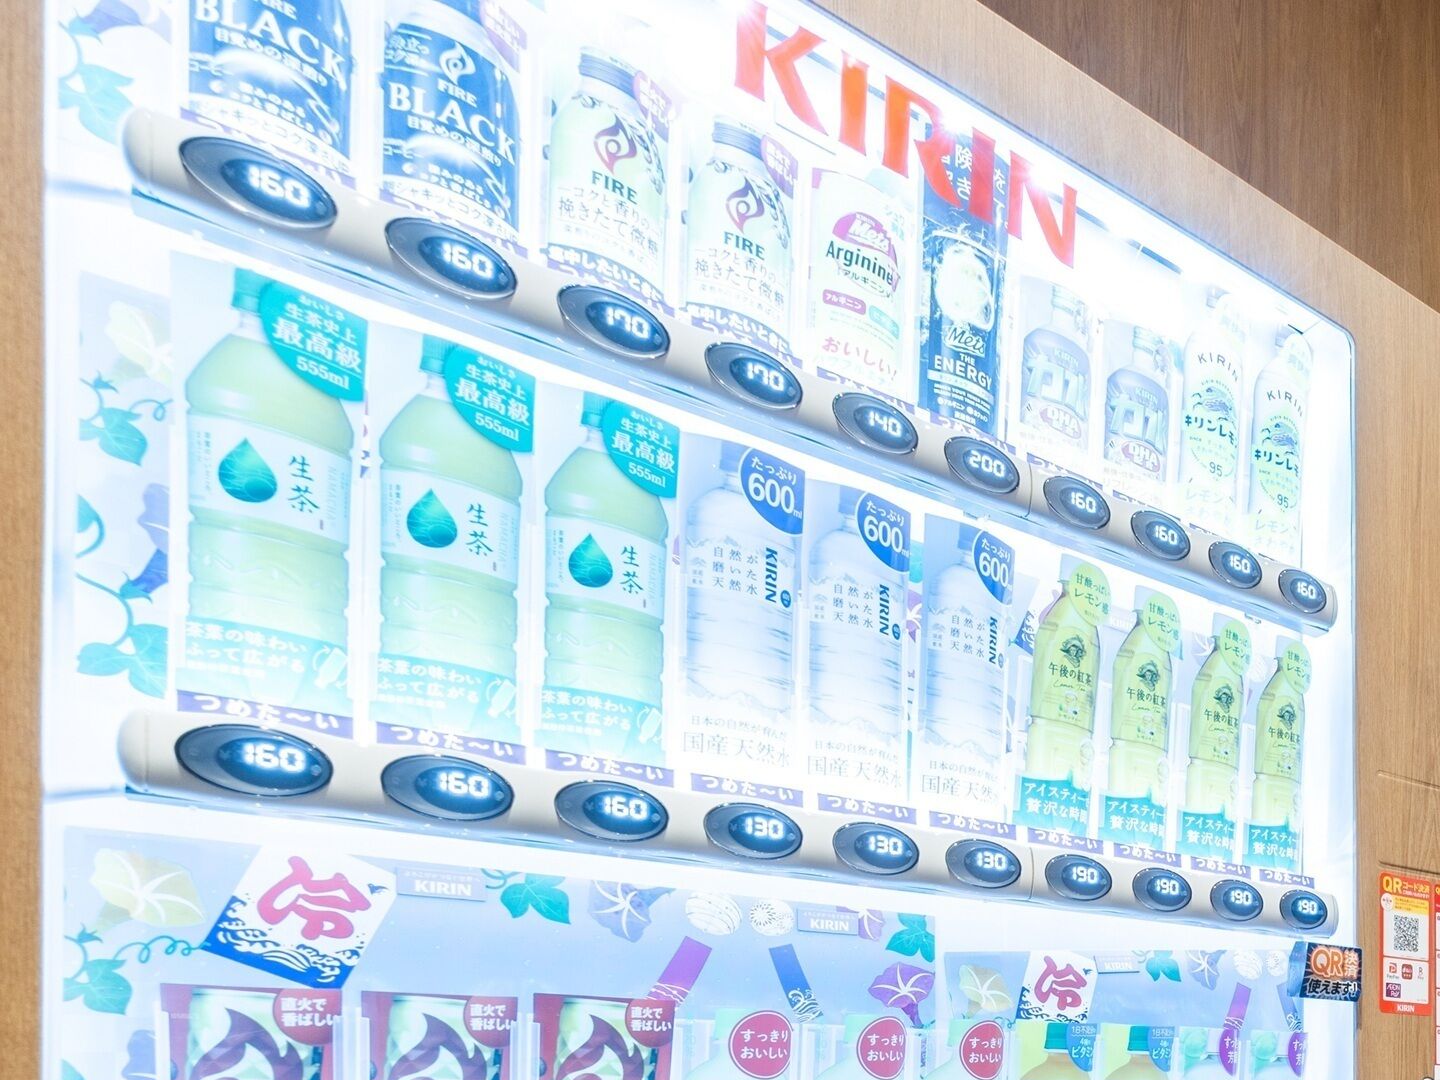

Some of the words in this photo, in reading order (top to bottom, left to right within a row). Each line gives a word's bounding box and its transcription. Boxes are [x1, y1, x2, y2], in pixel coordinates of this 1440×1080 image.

[389, 81, 516, 166] BLACK
[735, 2, 1078, 269] KIRIN
[591, 170, 637, 206] FIRE
[723, 231, 765, 261] FIRE
[825, 240, 895, 287] Arginine
[286, 302, 358, 347] 生茶史上
[605, 307, 650, 339] 170
[273, 318, 363, 375] 最高級
[959, 352, 976, 367] THE
[296, 355, 351, 391] 555ml
[465, 364, 527, 401] 生茶史上
[747, 362, 786, 391] 170
[934, 354, 992, 391] ENERGY
[454, 378, 531, 426] 最高級
[475, 412, 521, 443] 555ml
[611, 431, 676, 474] 最高級
[968, 451, 1005, 477] 200
[287, 455, 320, 514] 生茶
[628, 461, 667, 489] 555ml
[750, 456, 798, 485] たっぷり
[865, 499, 905, 528] たっぷり
[464, 503, 495, 558] 生茶
[619, 546, 644, 595] 生茶
[764, 546, 778, 604] KIRIN
[879, 583, 891, 636] KIRIN
[244, 743, 306, 772] 160
[438, 771, 490, 798] 160
[603, 796, 648, 820] 160
[745, 816, 785, 840] 130
[868, 835, 903, 856] 130
[976, 852, 1007, 871] 130
[1072, 866, 1098, 884] 190
[256, 855, 372, 941] 冷
[414, 878, 472, 898] KIRIN
[1155, 879, 1178, 896] 190
[1230, 889, 1252, 906] 190
[1297, 899, 1318, 915] 190
[1033, 955, 1088, 1011] 冷
[1307, 979, 1358, 997] 使えます!
[280, 996, 328, 1013] 直火で
[631, 1005, 664, 1020] 直火で
[631, 1018, 672, 1033] 香ばしい
[740, 1028, 789, 1043] すっきり
[867, 1033, 905, 1047] すっきり
[740, 1045, 788, 1060] おいしい
[867, 1048, 905, 1063] おいしい
